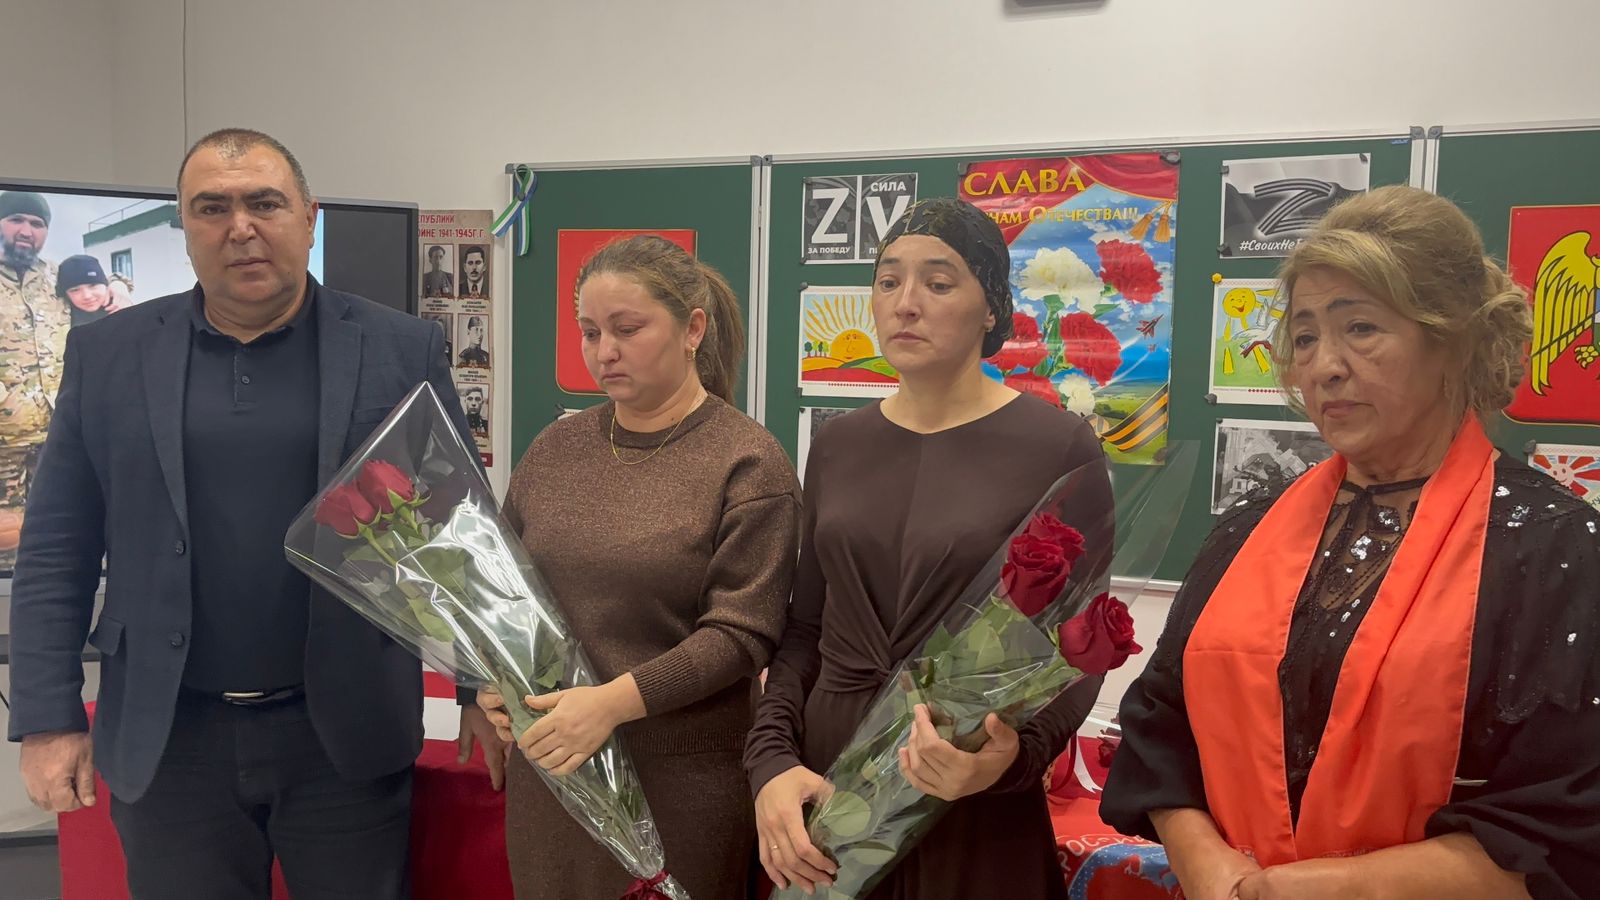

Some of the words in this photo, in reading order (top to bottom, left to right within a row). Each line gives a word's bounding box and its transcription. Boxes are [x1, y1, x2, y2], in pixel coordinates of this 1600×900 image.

[870, 181, 907, 192] СИЛА
[963, 168, 1087, 196] СЛАВА
[417, 214, 455, 224] ПУБЛИКИ
[811, 187, 850, 244] Z
[865, 195, 911, 242] V
[985, 209, 1023, 225] НАМ
[820, 246, 851, 254] ПОБЕДУ
